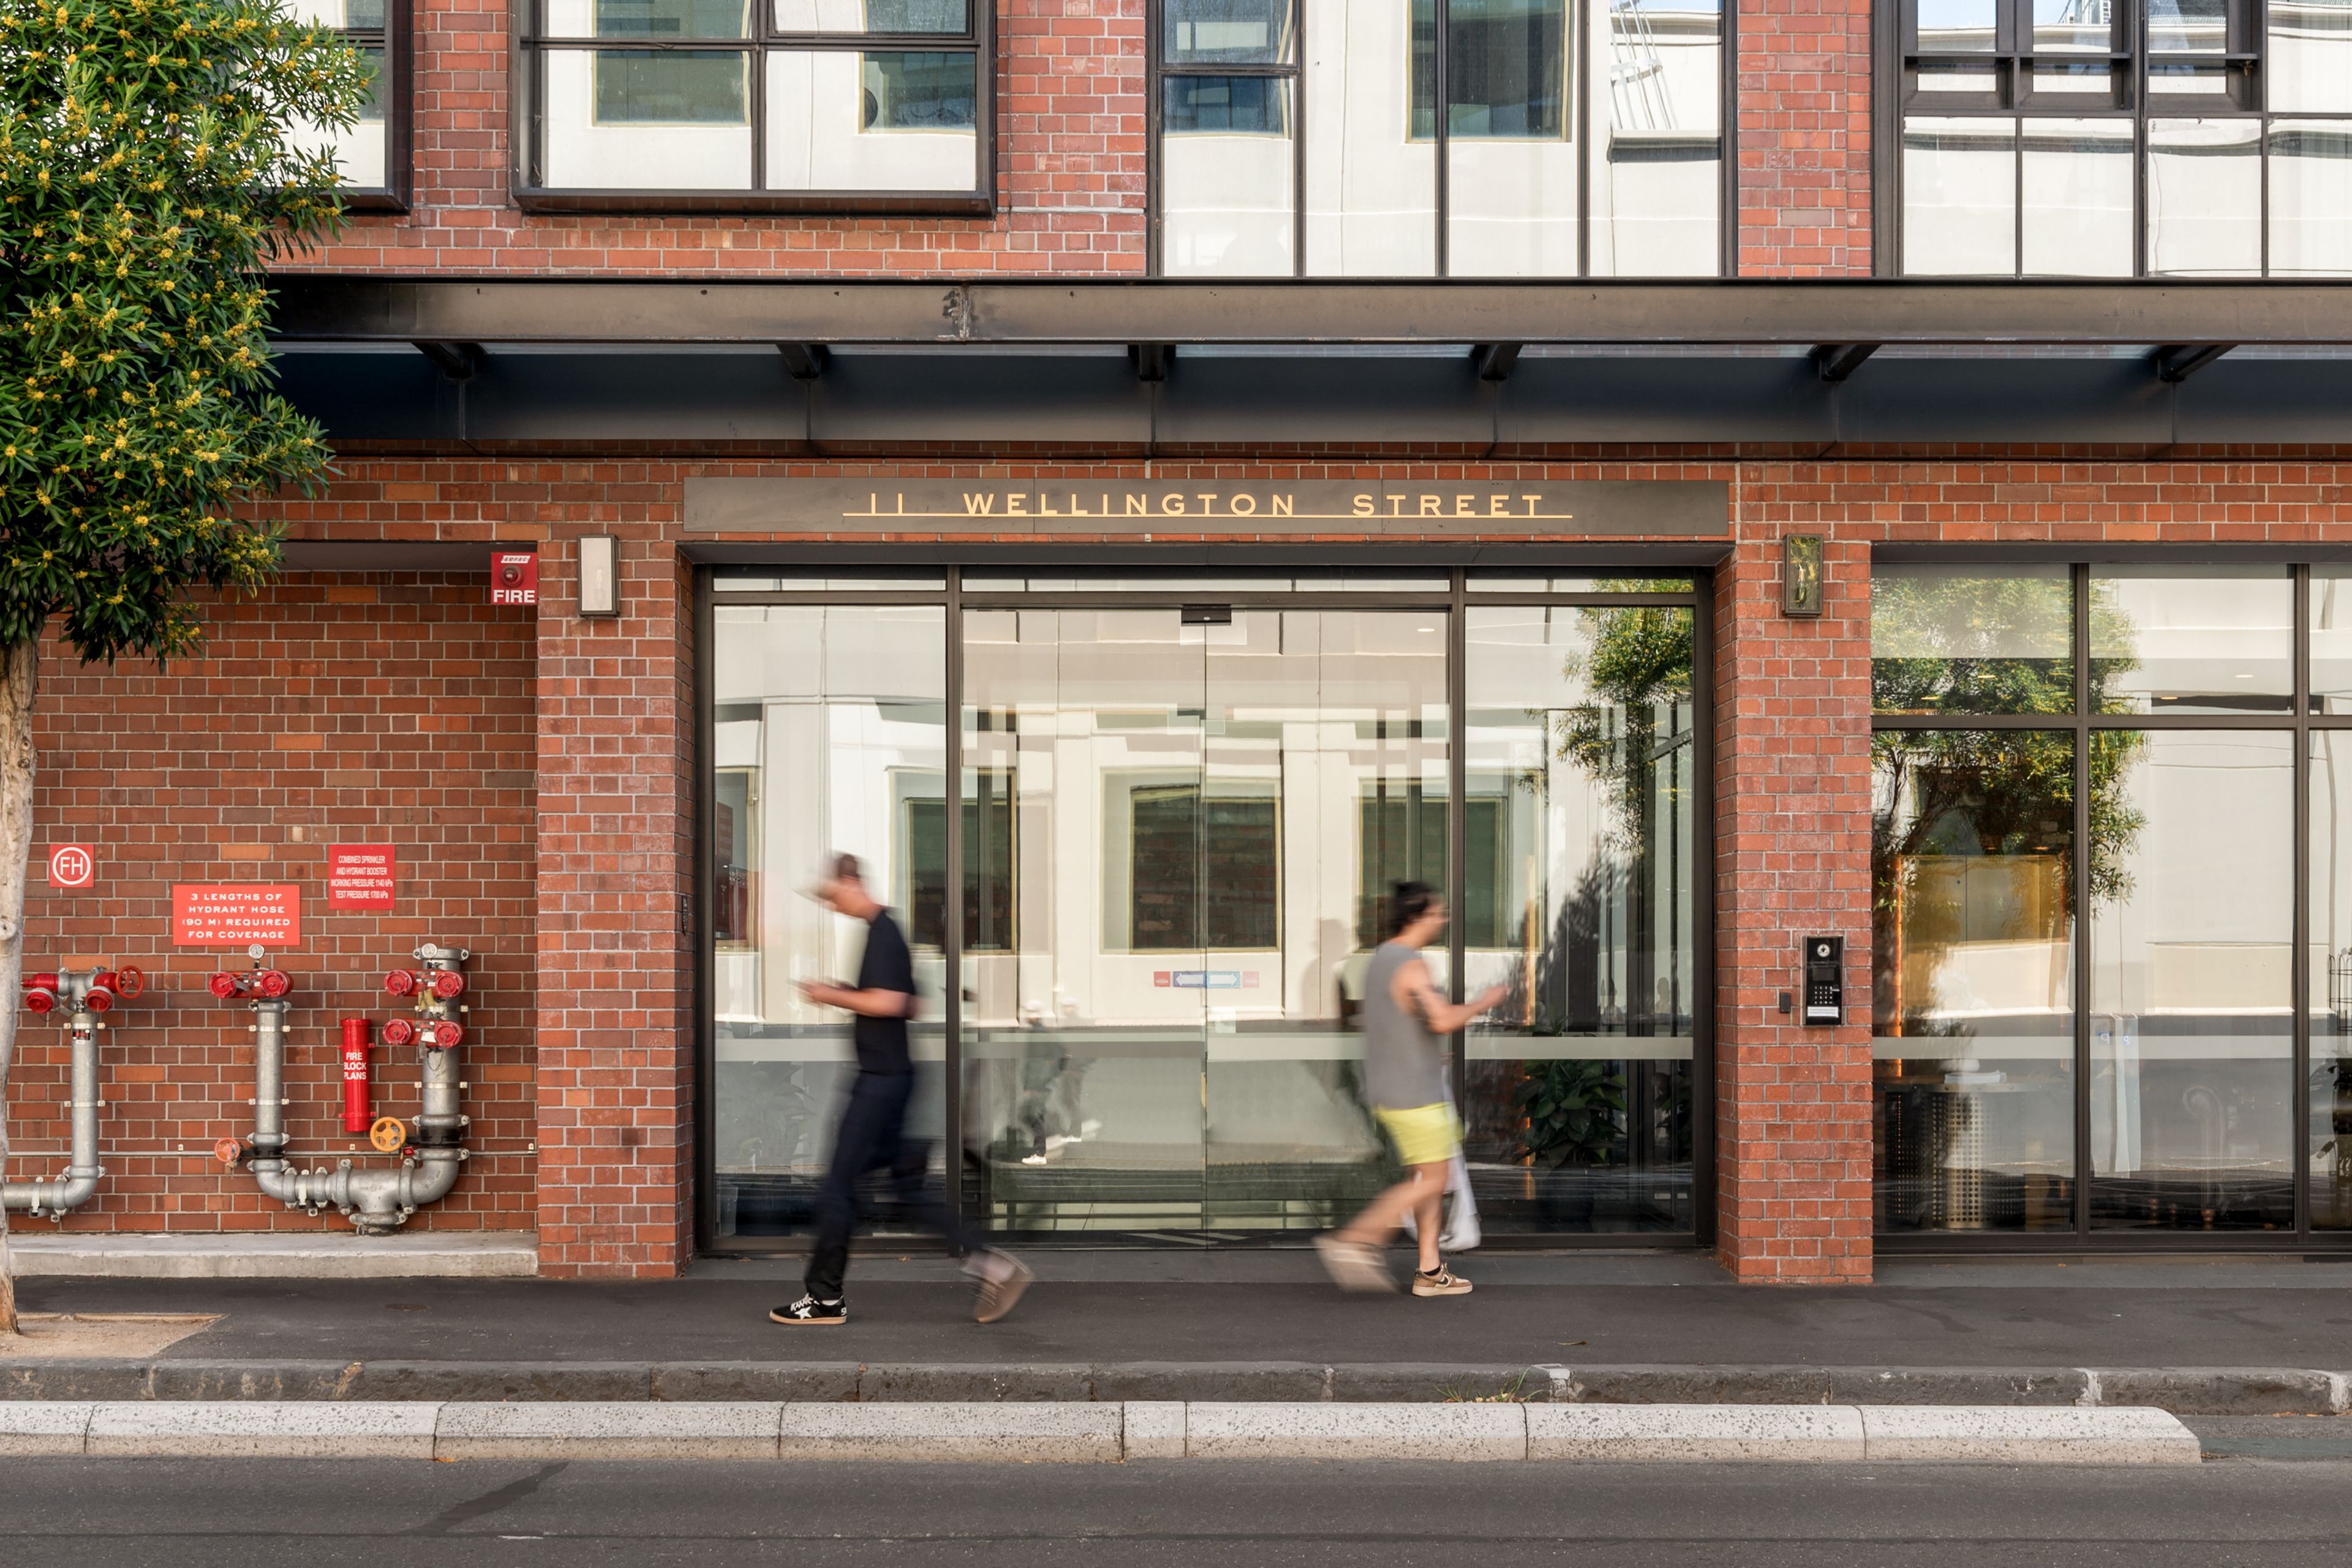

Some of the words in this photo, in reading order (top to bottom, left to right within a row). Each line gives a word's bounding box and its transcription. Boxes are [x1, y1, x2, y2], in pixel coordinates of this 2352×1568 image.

[963, 493, 1293, 516] WELLINGTON
[1352, 494, 1542, 517] STREET
[494, 589, 535, 603] FIRE
[338, 855, 361, 864] COMBINED
[361, 855, 386, 864] SPRINKLER
[60, 856, 83, 876] FH
[336, 867, 346, 875] AND
[346, 867, 366, 875] HYDRANT
[366, 867, 388, 875] BOOSTER
[331, 878, 351, 887] WORKING
[352, 878, 375, 887] PRESSURE
[335, 890, 346, 899] TEST
[346, 890, 370, 899] PRESSURE
